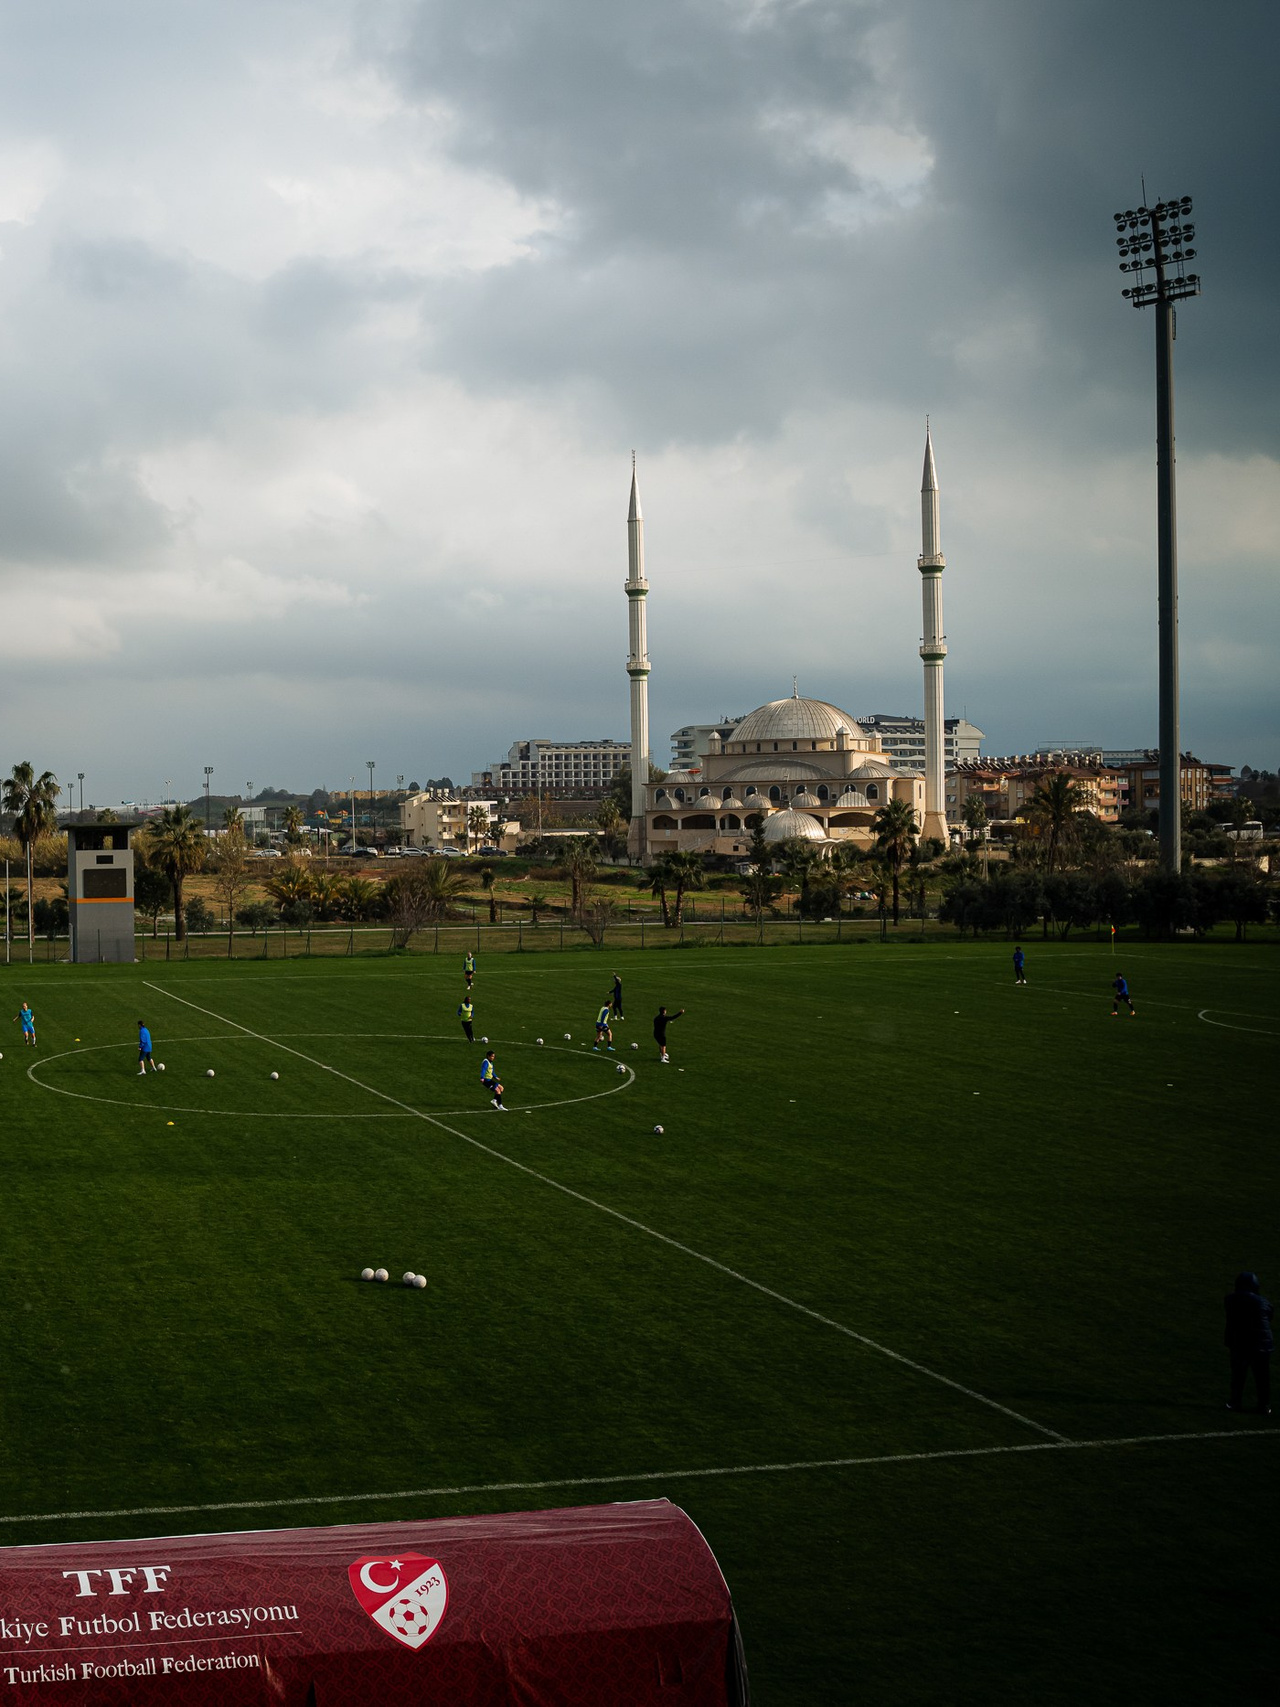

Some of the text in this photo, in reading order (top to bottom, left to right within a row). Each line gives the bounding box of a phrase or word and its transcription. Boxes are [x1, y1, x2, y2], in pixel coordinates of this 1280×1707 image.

[62, 1565, 172, 1598] TFF
[414, 1576, 441, 1597] 1923
[58, 1611, 141, 1637] Futbol
[148, 1604, 300, 1631] Federasyonu
[3, 1652, 260, 1685] Turkish Football Federation
